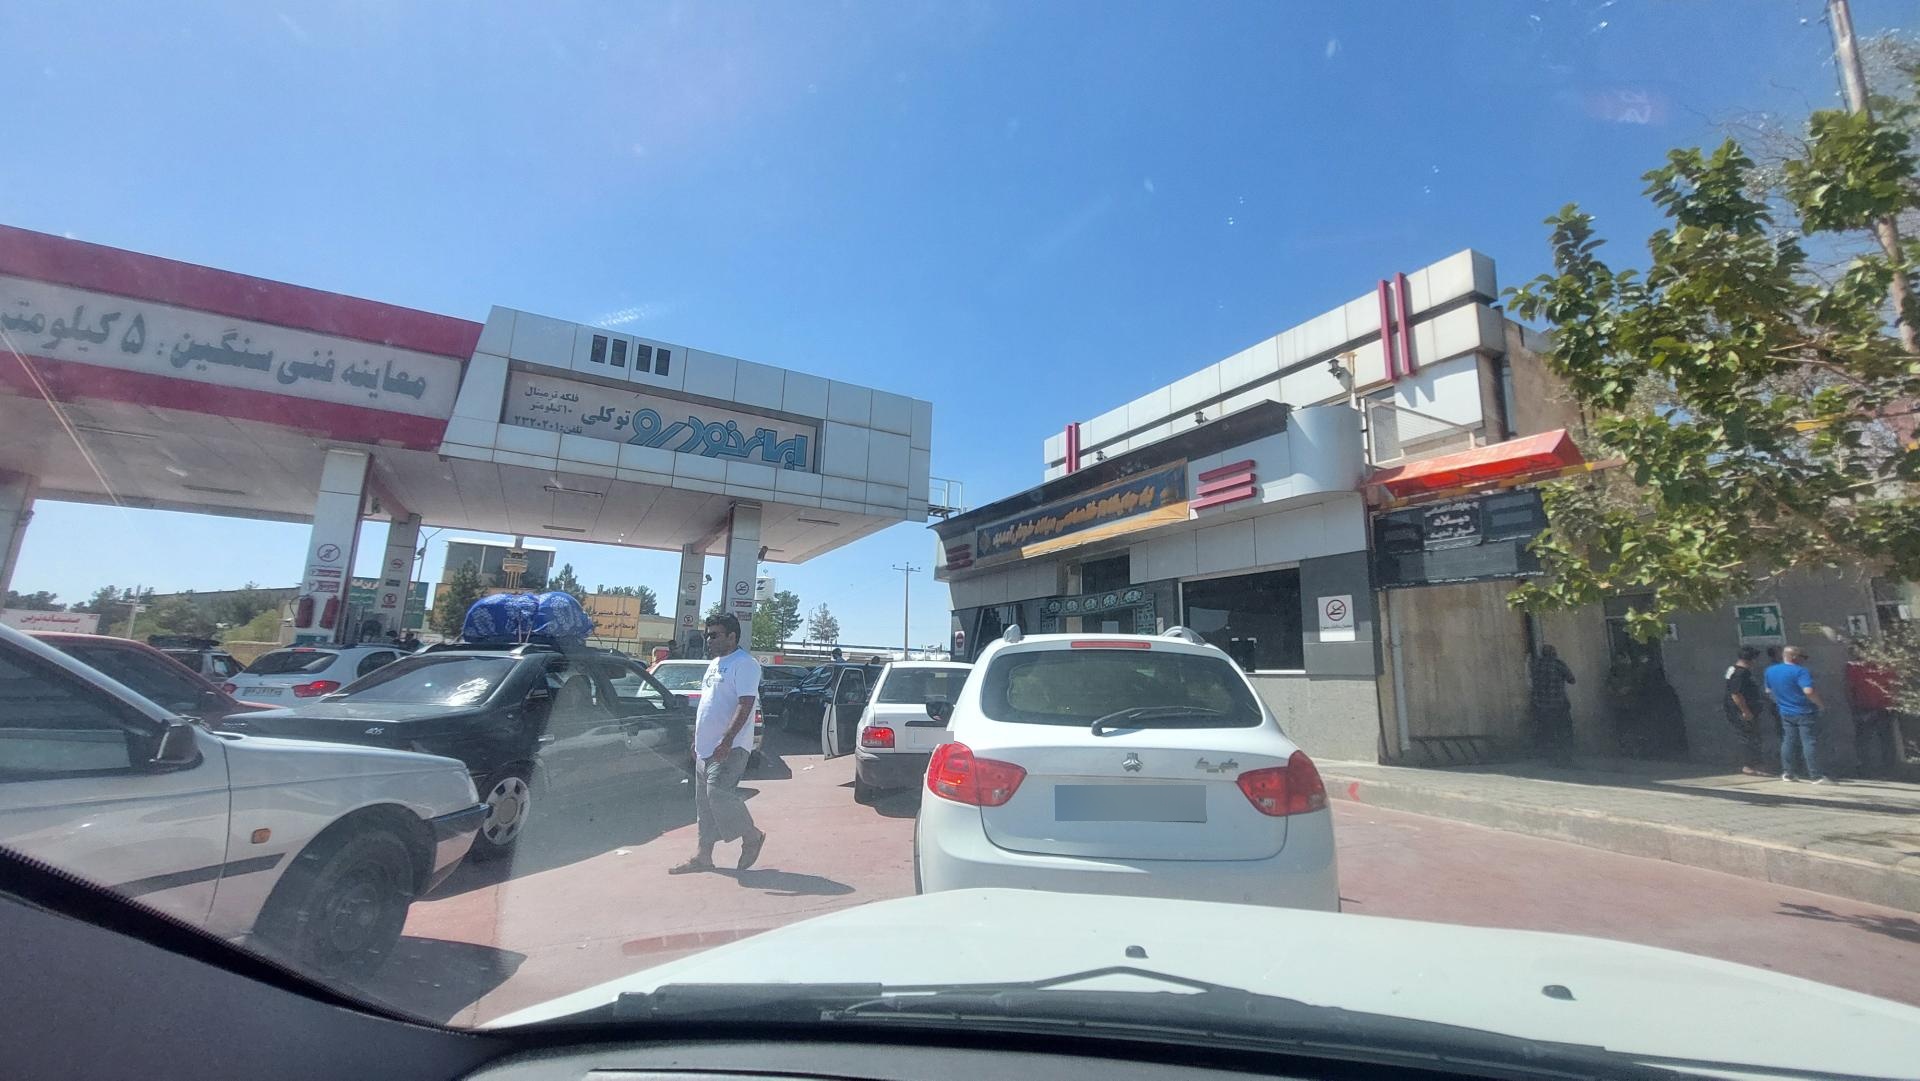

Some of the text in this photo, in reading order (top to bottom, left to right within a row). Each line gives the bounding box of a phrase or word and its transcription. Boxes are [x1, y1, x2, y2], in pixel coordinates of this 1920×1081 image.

[120, 312, 147, 355] ۵
[276, 348, 337, 385] فنی
[341, 359, 427, 400] معاینه
[525, 386, 579, 403] فلکه ترمینال
[580, 405, 632, 431] توکلی
